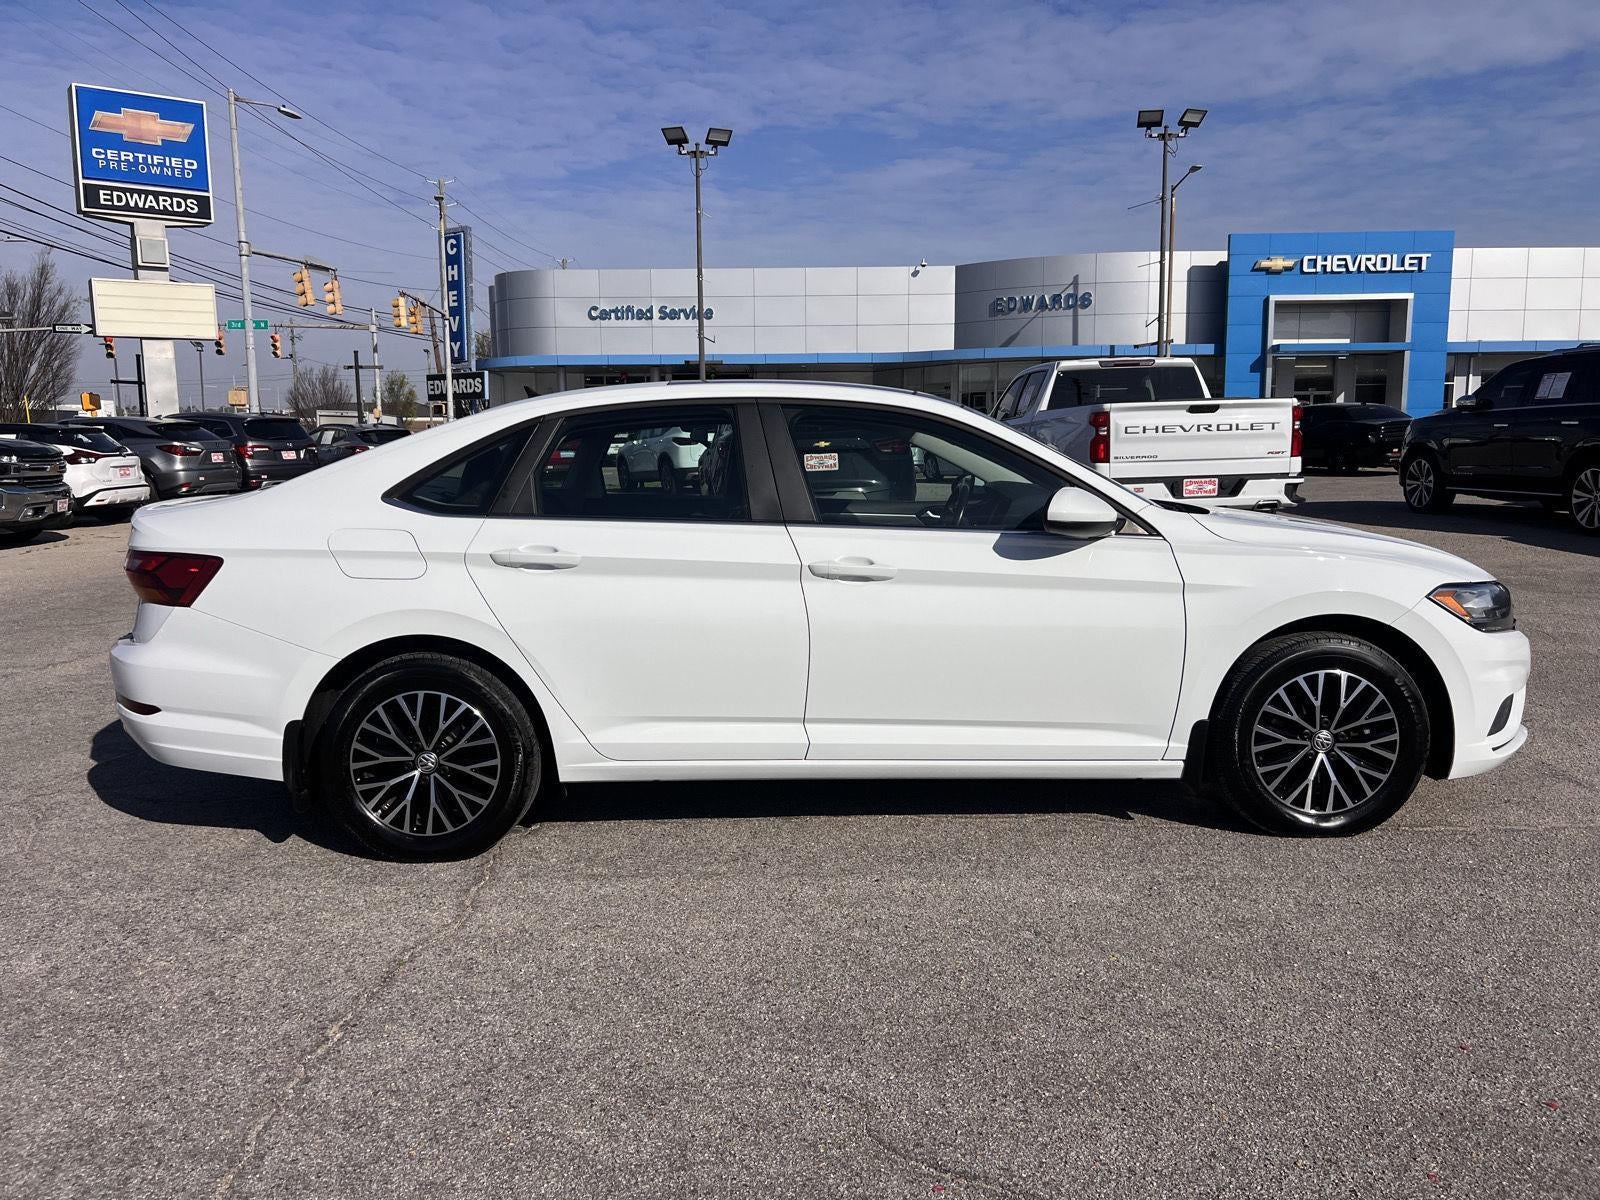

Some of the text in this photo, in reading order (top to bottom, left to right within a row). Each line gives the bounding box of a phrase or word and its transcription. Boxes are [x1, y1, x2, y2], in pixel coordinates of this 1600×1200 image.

[91, 147, 198, 170] CERTIFIED
[98, 159, 193, 179] PRE-OWNED
[99, 189, 199, 214] EDWARDS
[1302, 253, 1432, 273] CHEVROLET
[446, 238, 461, 358] CHEVY
[994, 292, 1093, 314] EDWARDS
[587, 304, 714, 321] Certified Servie
[1124, 421, 1281, 435] CHEVROLET
[805, 454, 837, 462] EDWARDS
